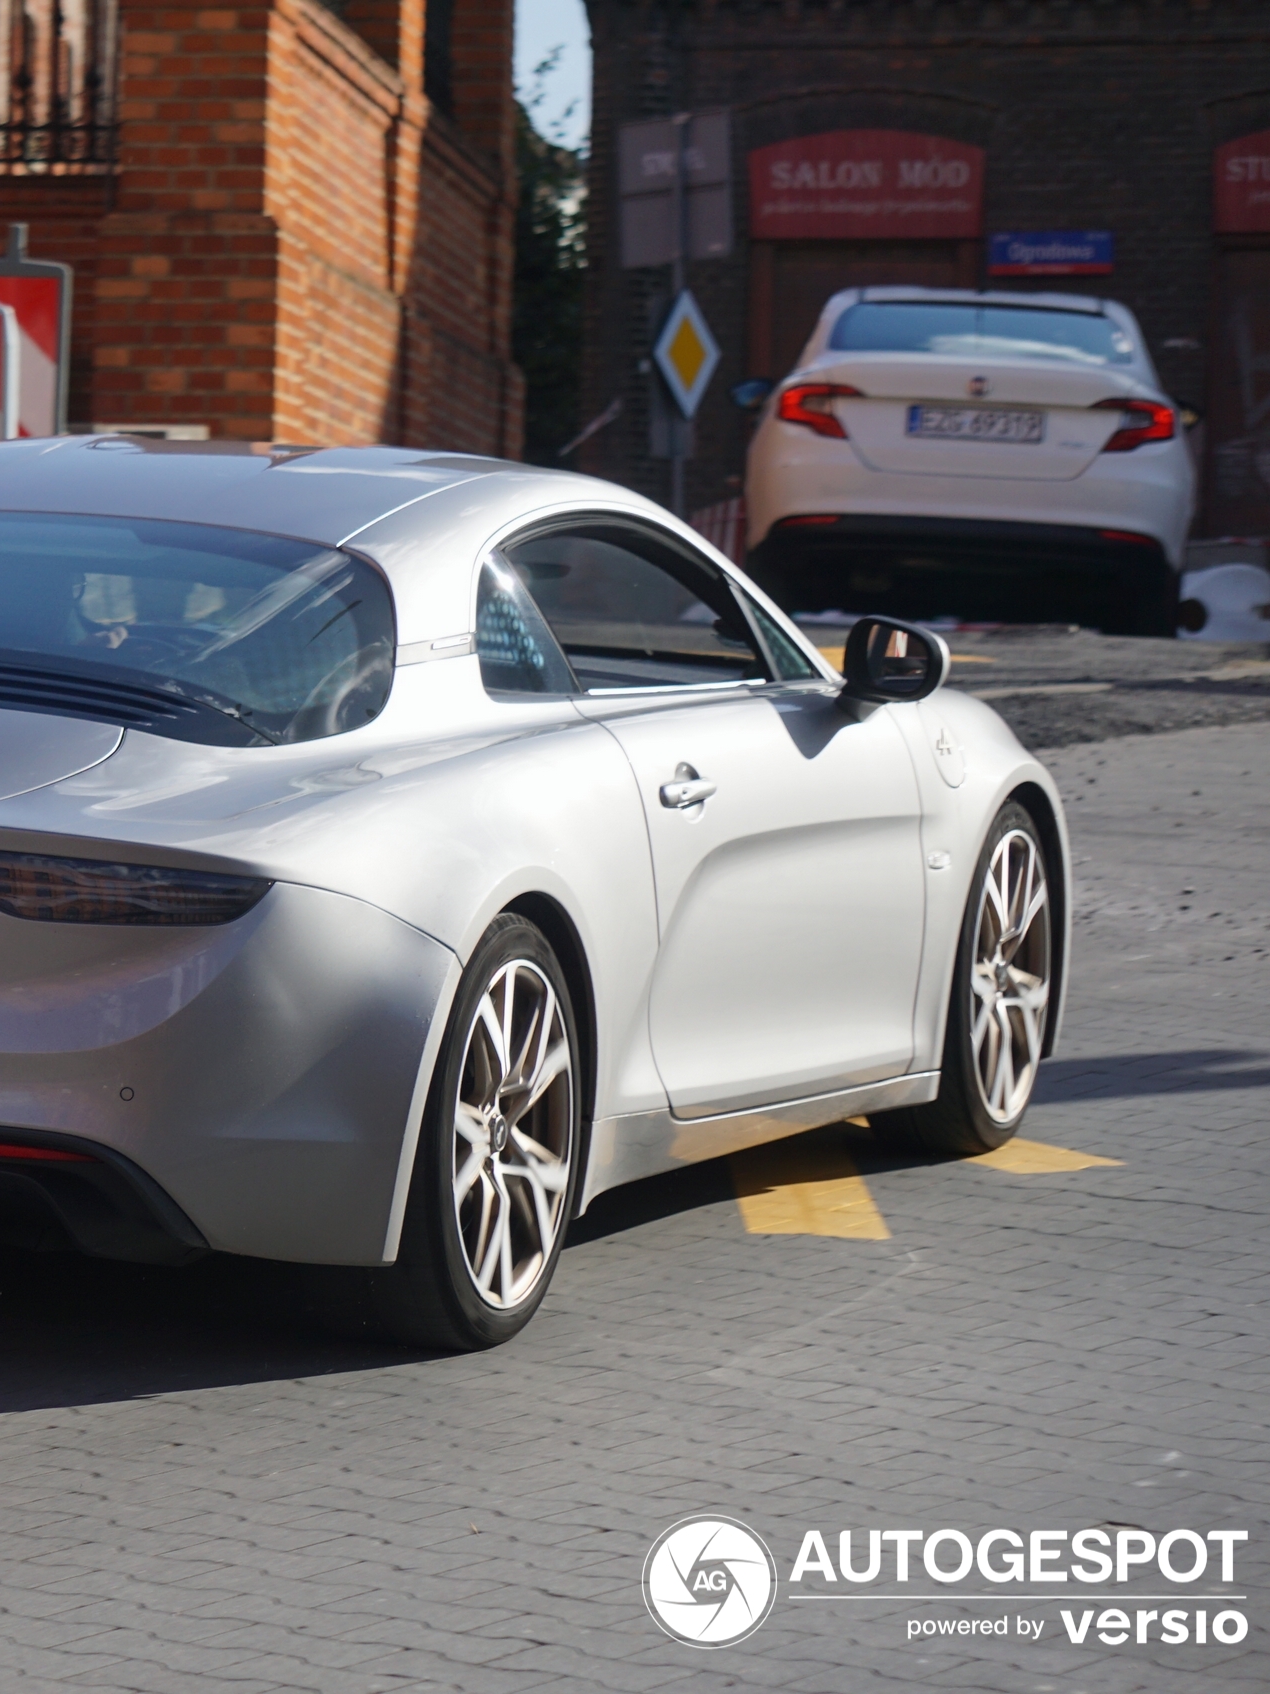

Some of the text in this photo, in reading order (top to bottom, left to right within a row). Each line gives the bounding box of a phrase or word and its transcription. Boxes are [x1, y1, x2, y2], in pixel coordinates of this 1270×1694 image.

[770, 153, 970, 189] SALON MÓD
[1008, 241, 1096, 265] Ogrodowa
